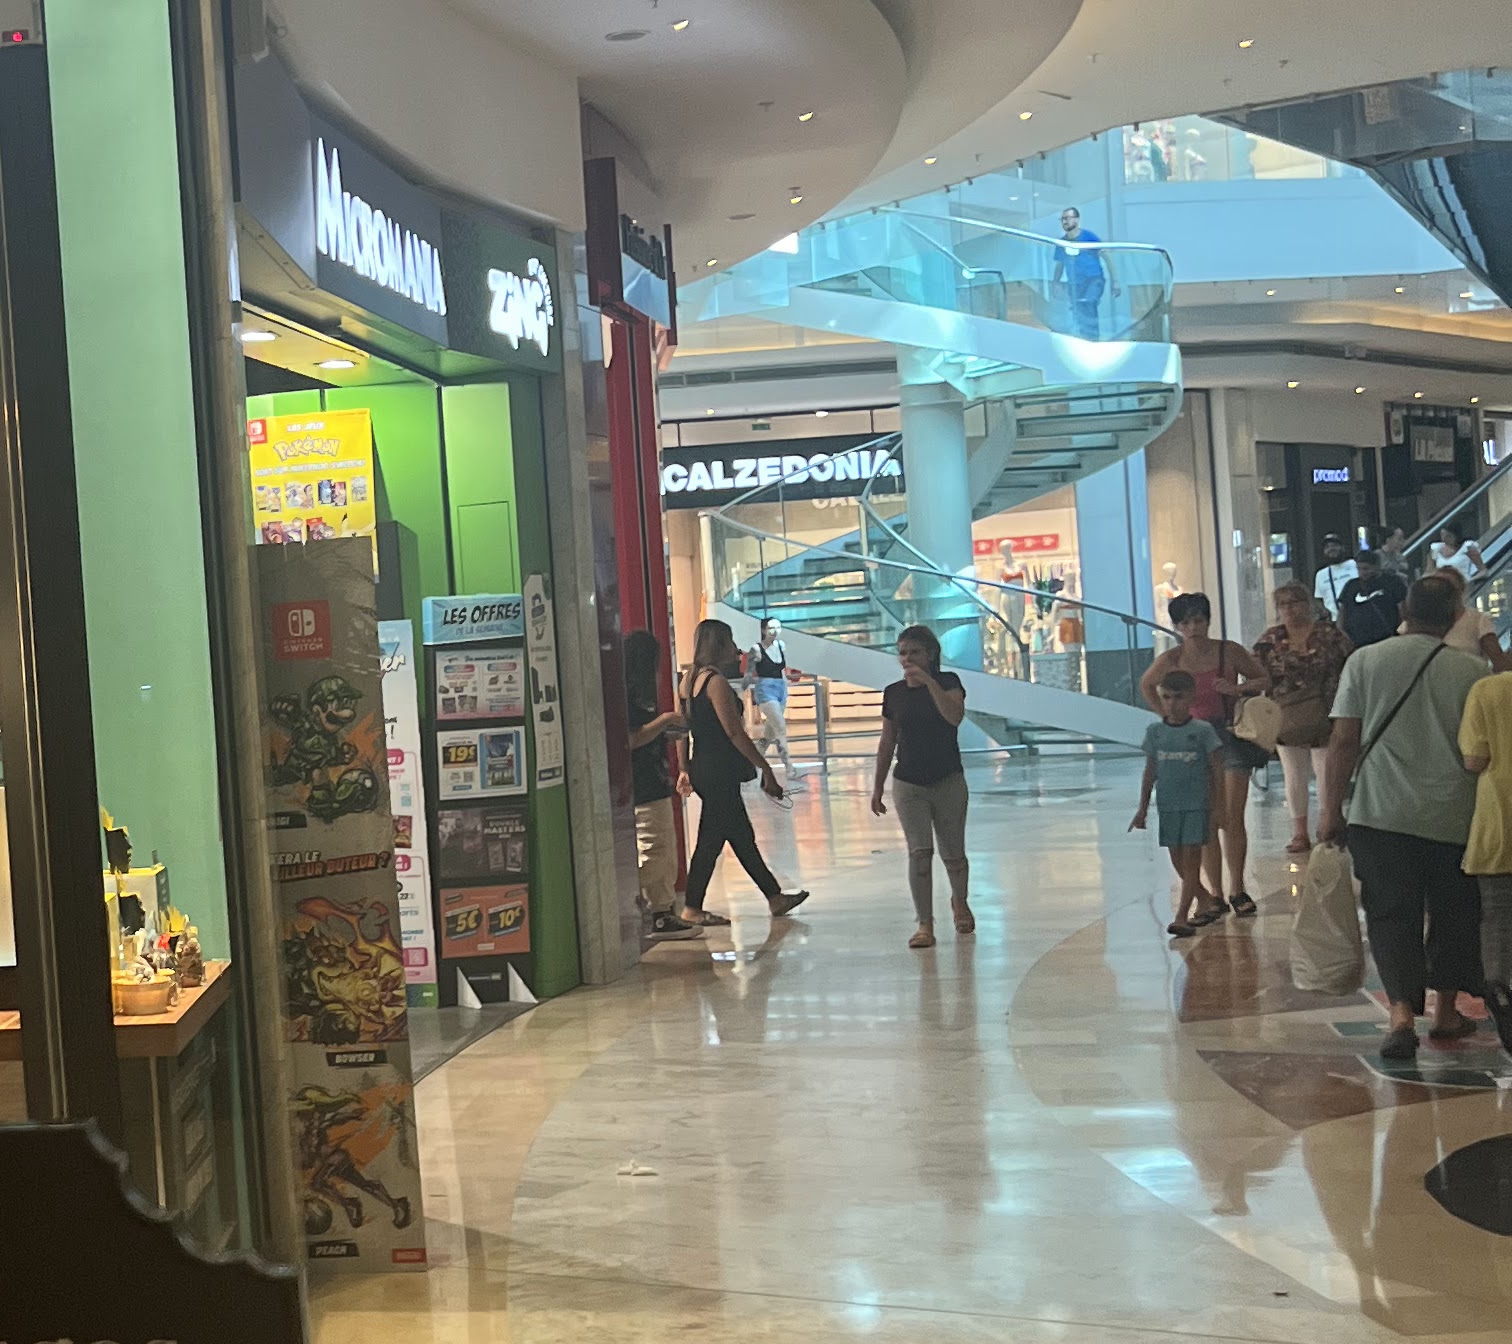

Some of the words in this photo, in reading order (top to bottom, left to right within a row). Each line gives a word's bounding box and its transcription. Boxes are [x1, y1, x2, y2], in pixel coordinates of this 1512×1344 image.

[317, 137, 447, 316] MICROMANIA
[663, 450, 902, 493] CALZEDONIA
[442, 606, 467, 625] LES
[471, 602, 521, 624] OFFRES
[284, 642, 324, 653] SWITCH
[334, 1053, 377, 1064] BOWSER
